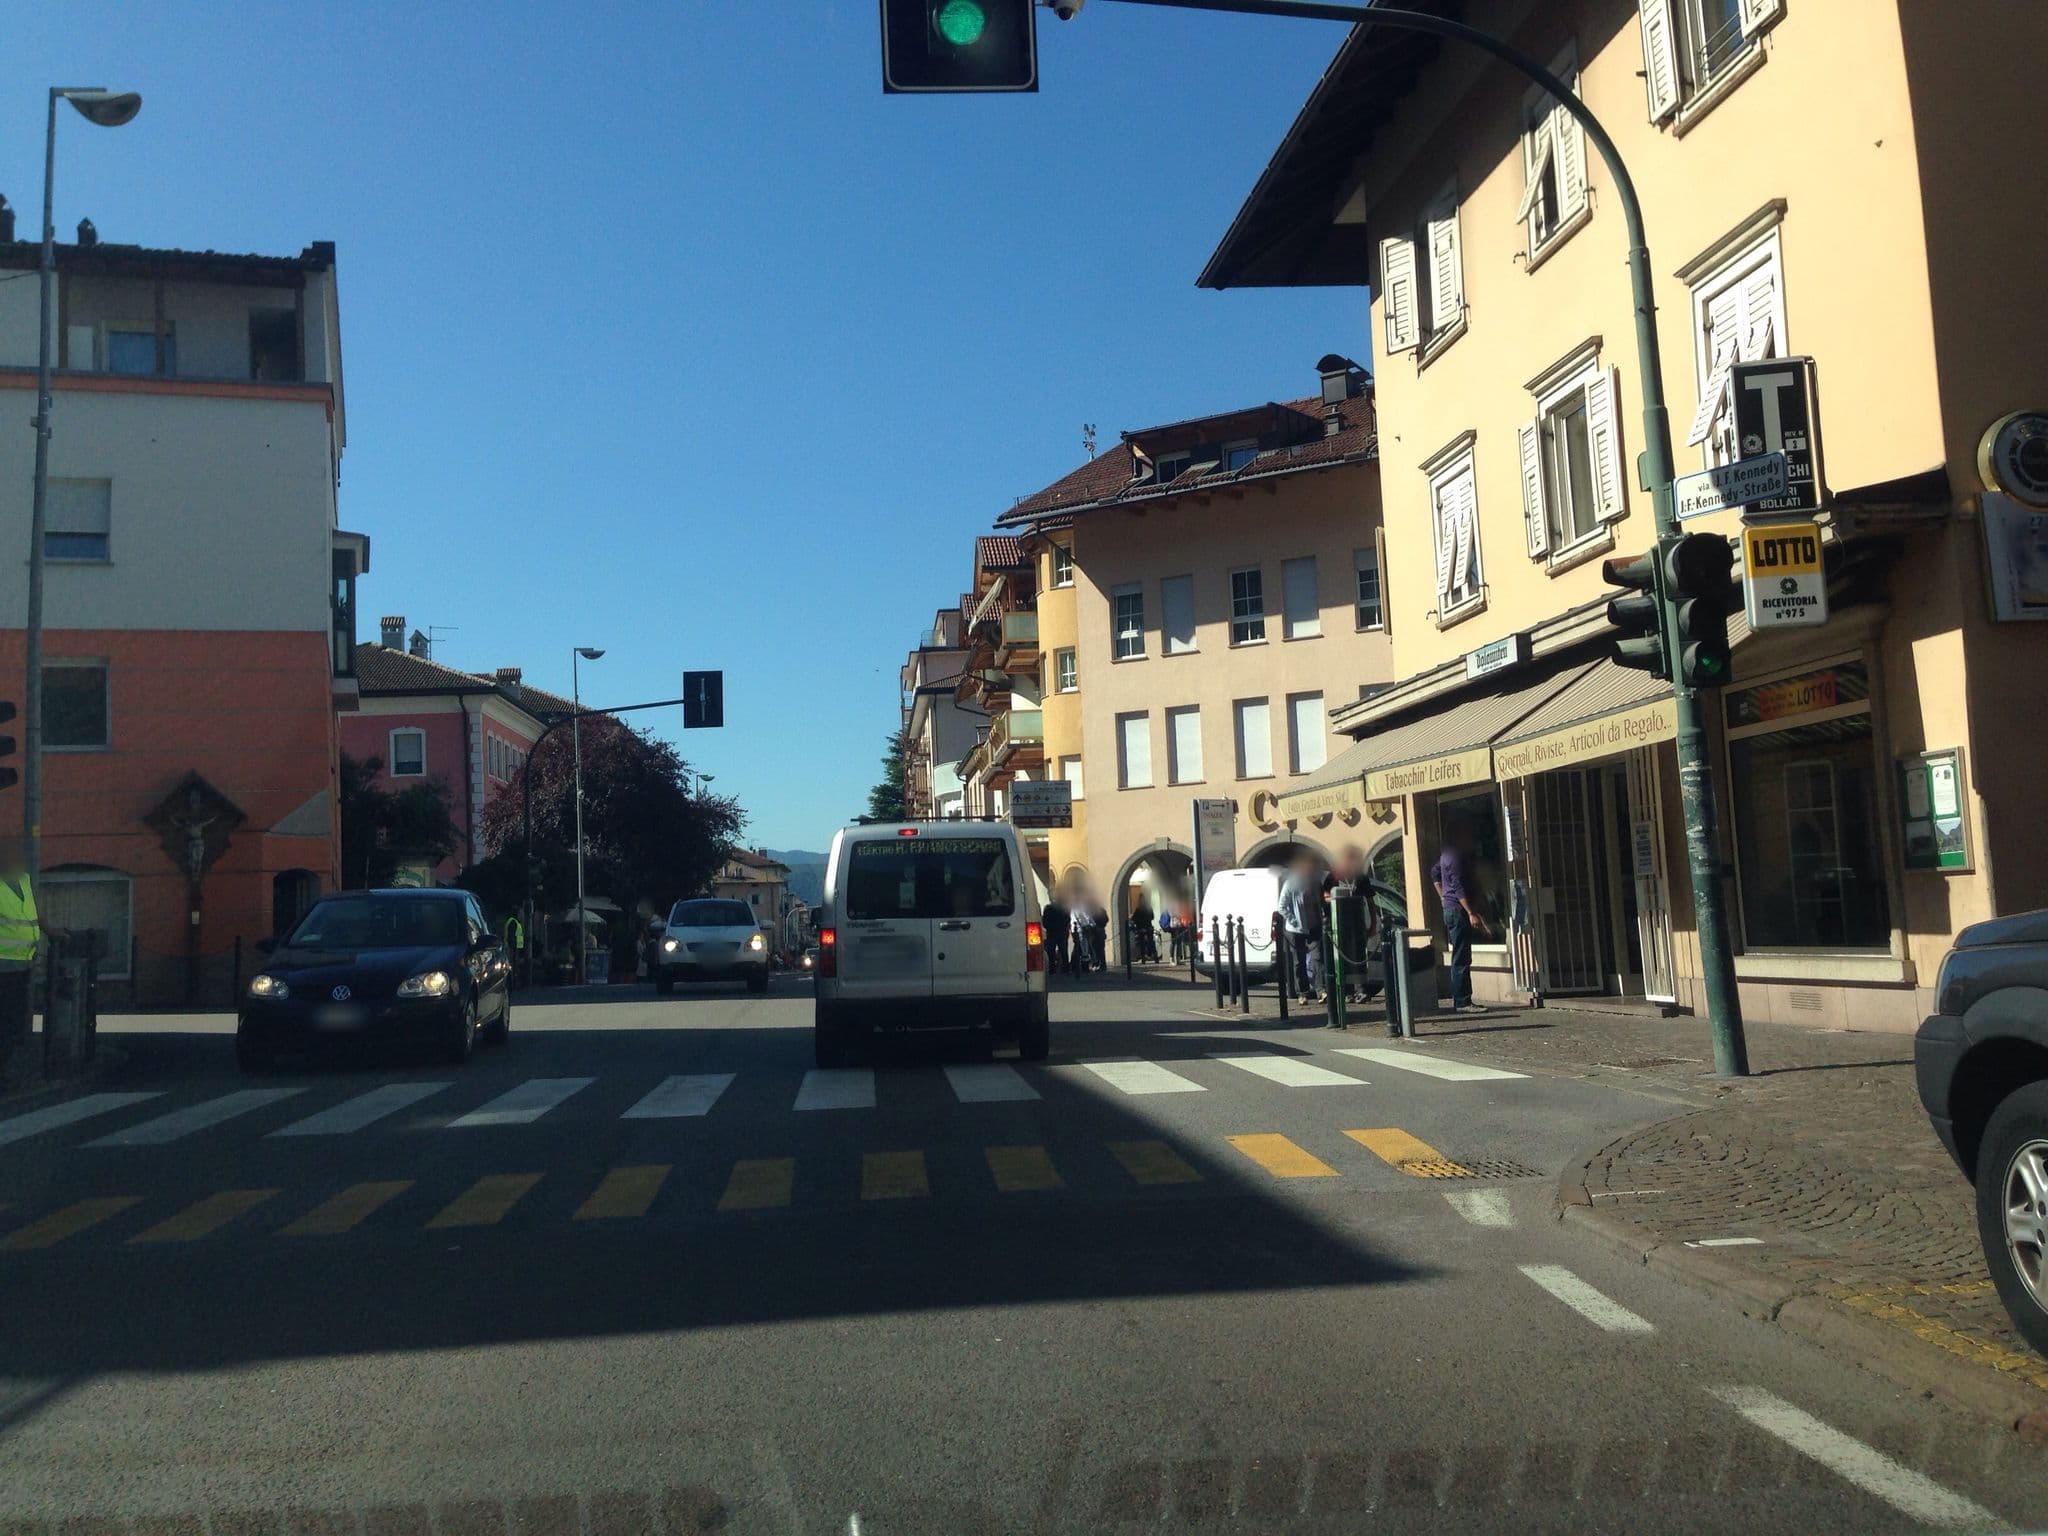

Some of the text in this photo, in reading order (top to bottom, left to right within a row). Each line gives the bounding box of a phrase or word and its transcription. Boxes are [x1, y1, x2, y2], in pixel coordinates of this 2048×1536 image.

[1697, 483, 1710, 492] via
[1733, 459, 1780, 483] Kennedy
[1787, 463, 1810, 477] CHI
[1759, 495, 1801, 509] BOLLATI
[1753, 536, 1816, 567] LOTTO
[1762, 594, 1818, 609] RICEVITORIA
[1534, 739, 1567, 762] Riviste,
[1569, 725, 1606, 753] Articoli
[1607, 720, 1621, 743] da
[1429, 759, 1462, 782] Leifers
